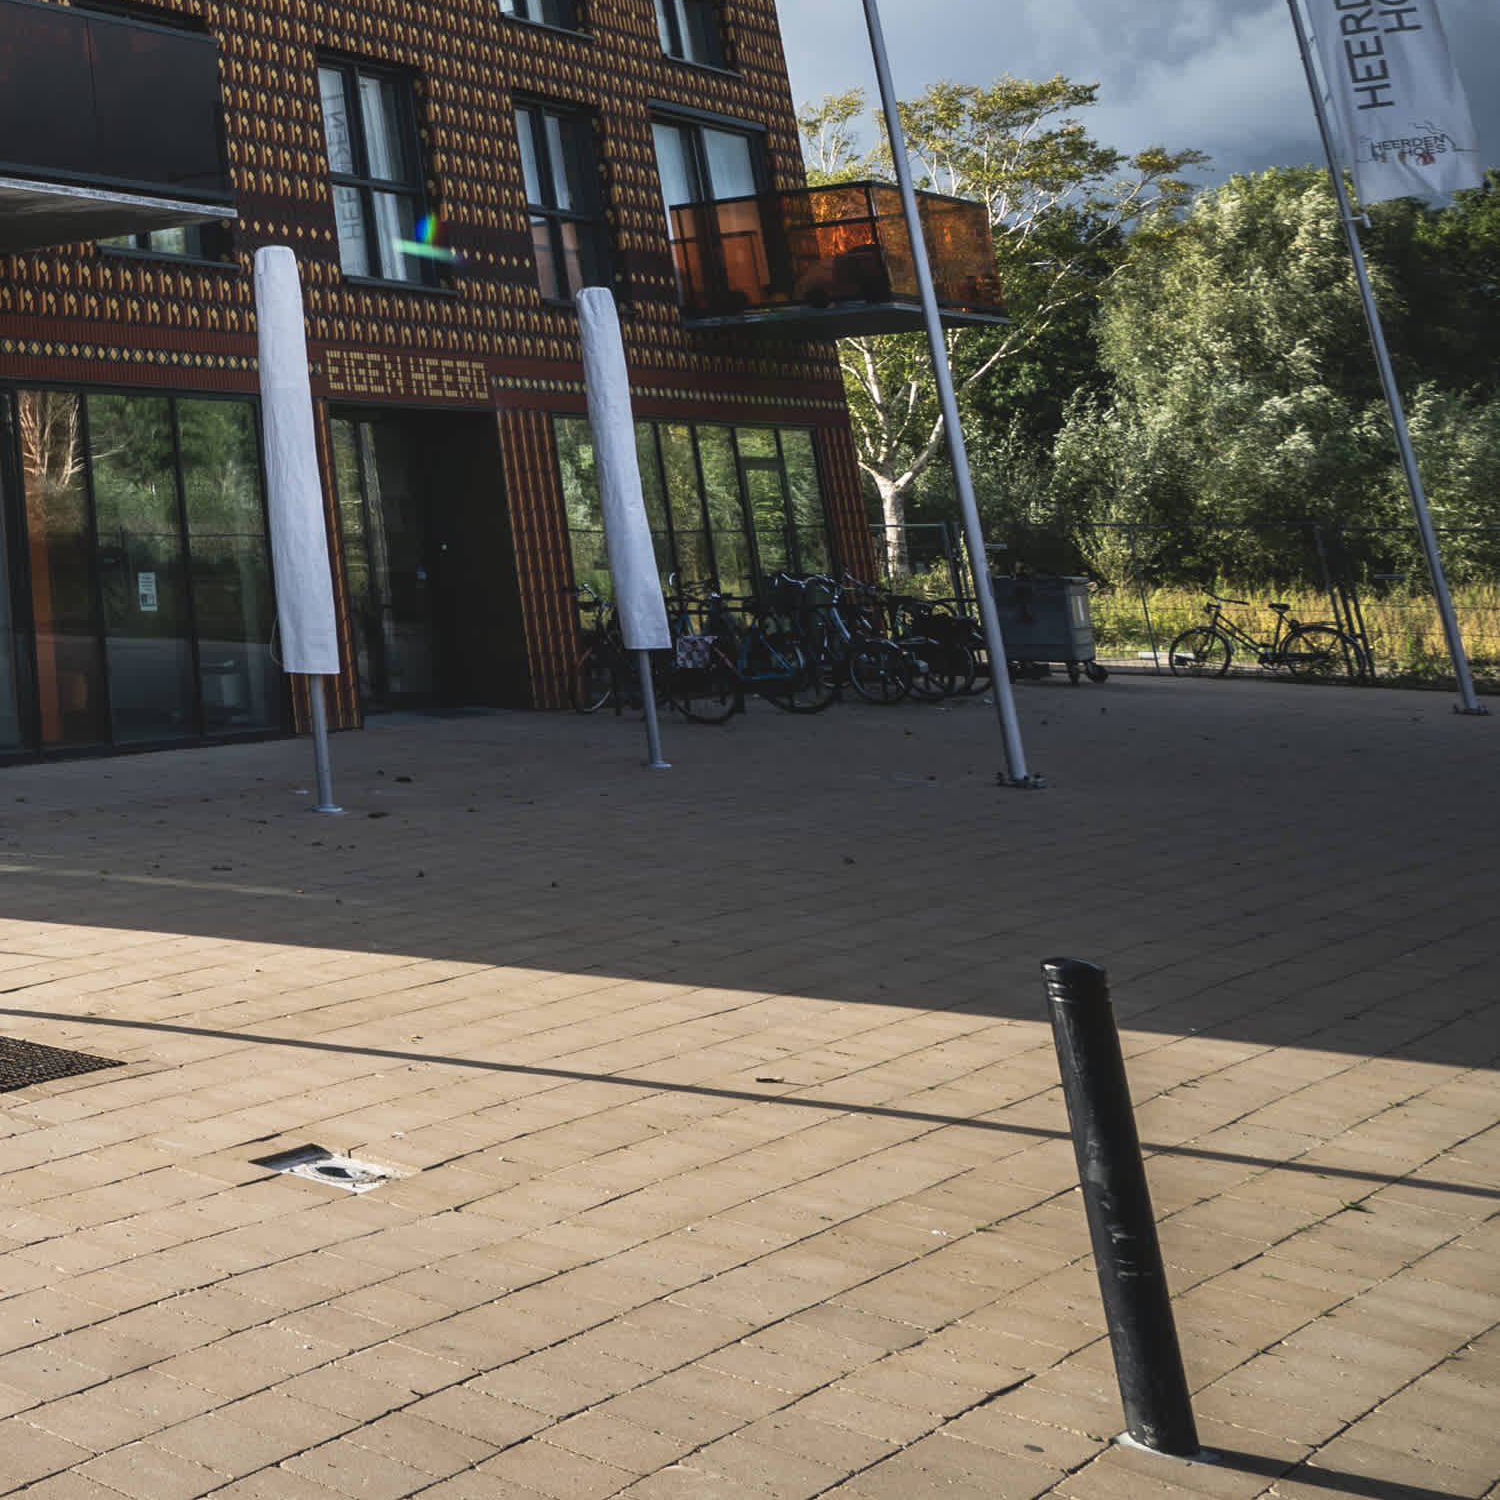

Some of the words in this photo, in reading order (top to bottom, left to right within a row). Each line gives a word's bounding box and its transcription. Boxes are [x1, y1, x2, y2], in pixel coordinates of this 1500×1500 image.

[1371, 133, 1446, 151] HEERDEN
[326, 350, 404, 394] EIGEN
[410, 356, 489, 399] HEERD
